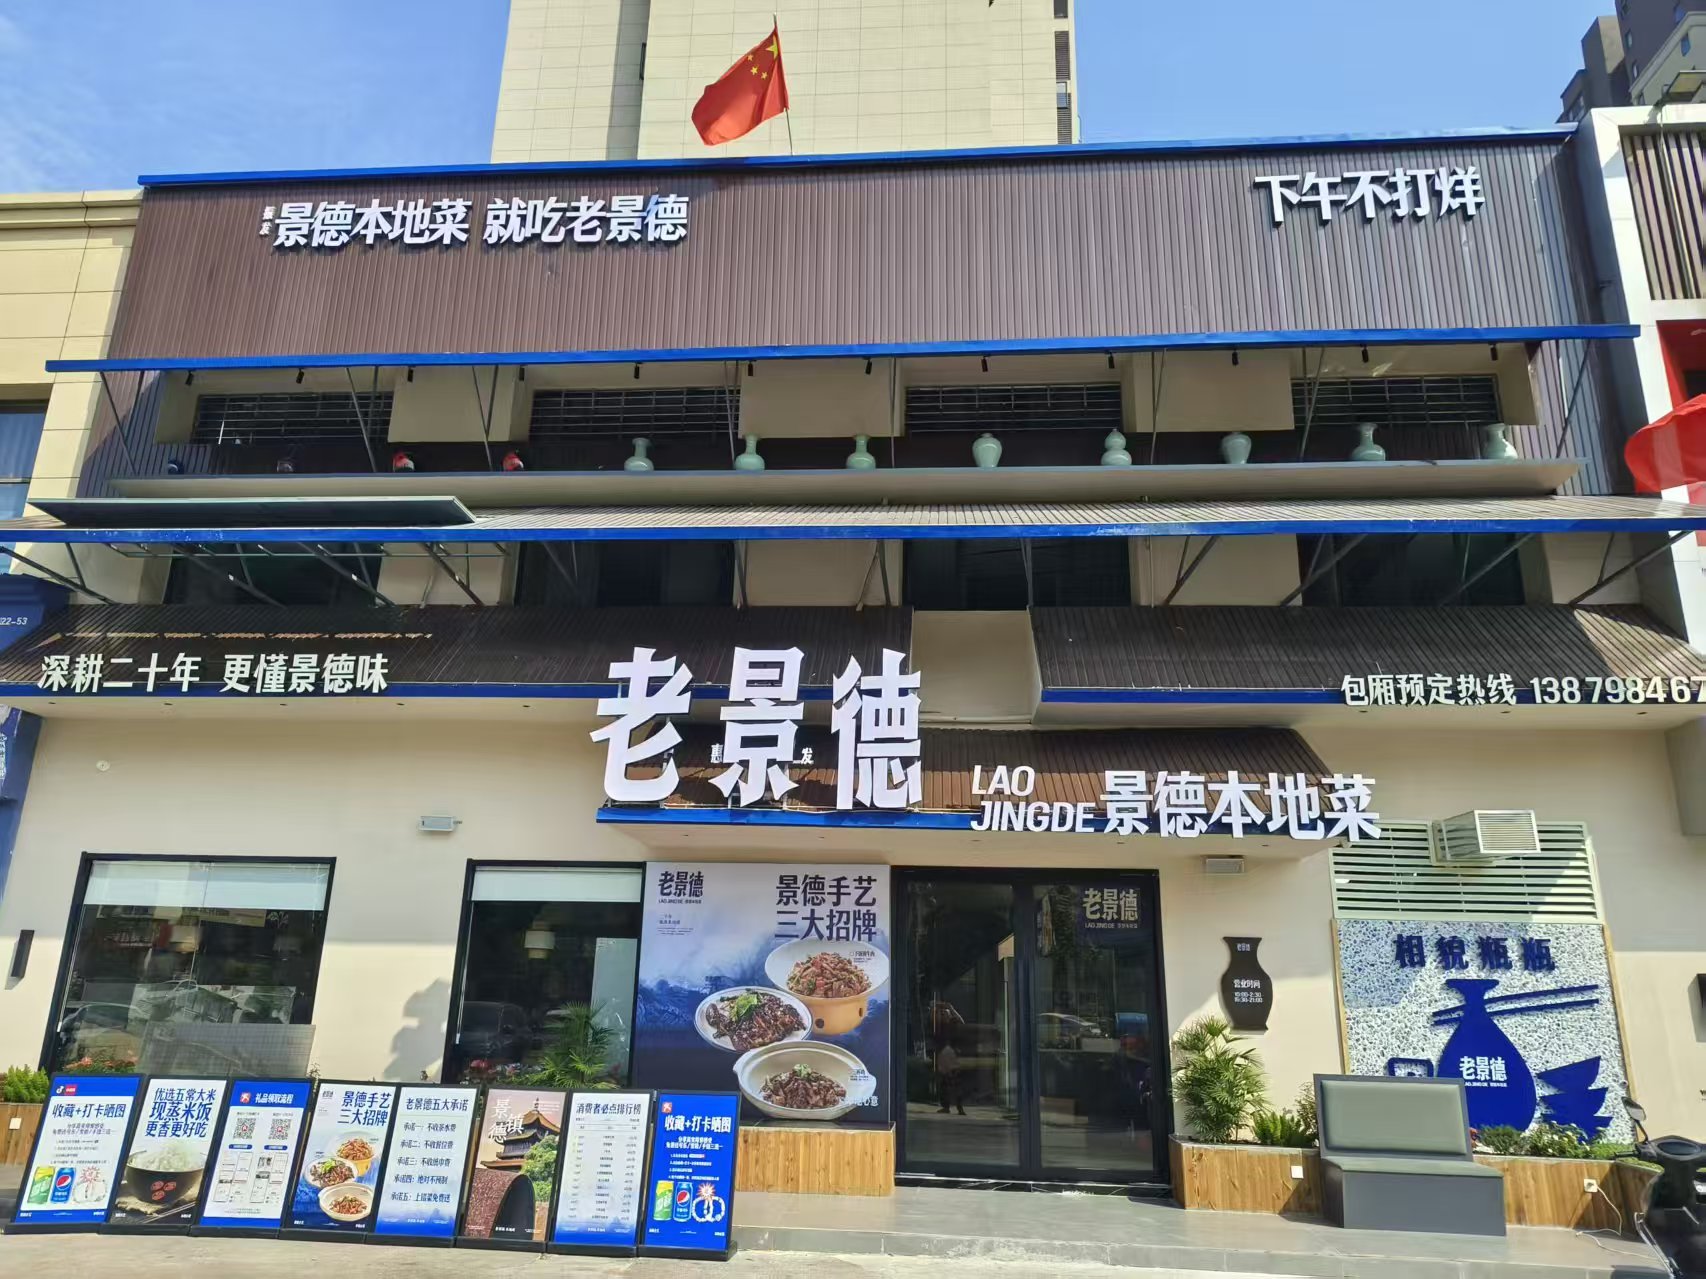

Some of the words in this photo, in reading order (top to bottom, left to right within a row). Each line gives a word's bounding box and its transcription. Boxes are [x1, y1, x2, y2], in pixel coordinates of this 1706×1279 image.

[1254, 166, 1486, 222] 下午不打烊
[273, 198, 473, 247] 景德本地菜
[482, 194, 690, 244] 就吃老景德
[37, 653, 202, 693] 深耕二十年
[219, 653, 389, 694] 更懂景德味
[1341, 673, 1517, 706] 包厢预定热线
[590, 646, 923, 810] 老景德
[971, 765, 1035, 797] LAO
[970, 800, 1095, 833] JINGDE
[1100, 770, 1381, 841] 景德本地菜
[658, 871, 704, 897] 老景德
[776, 875, 877, 907] 景德手艺
[1083, 888, 1138, 921] 老景德
[775, 909, 877, 942] 三大招牌
[1459, 1056, 1508, 1081] 老景德
[154, 1088, 216, 1102] 优选五常大米
[342, 1091, 391, 1108] 景德手艺
[406, 1098, 469, 1111] 老景德五大承诺
[576, 1103, 641, 1115] 消费者必点排行榜
[52, 1103, 126, 1118] 收藏+打卡晒图
[149, 1102, 213, 1121] 现蒸米饭
[338, 1109, 388, 1127] 三大招牌
[664, 1115, 731, 1132] 收藏+打卡晒图
[145, 1121, 209, 1138] 更香更好吃
